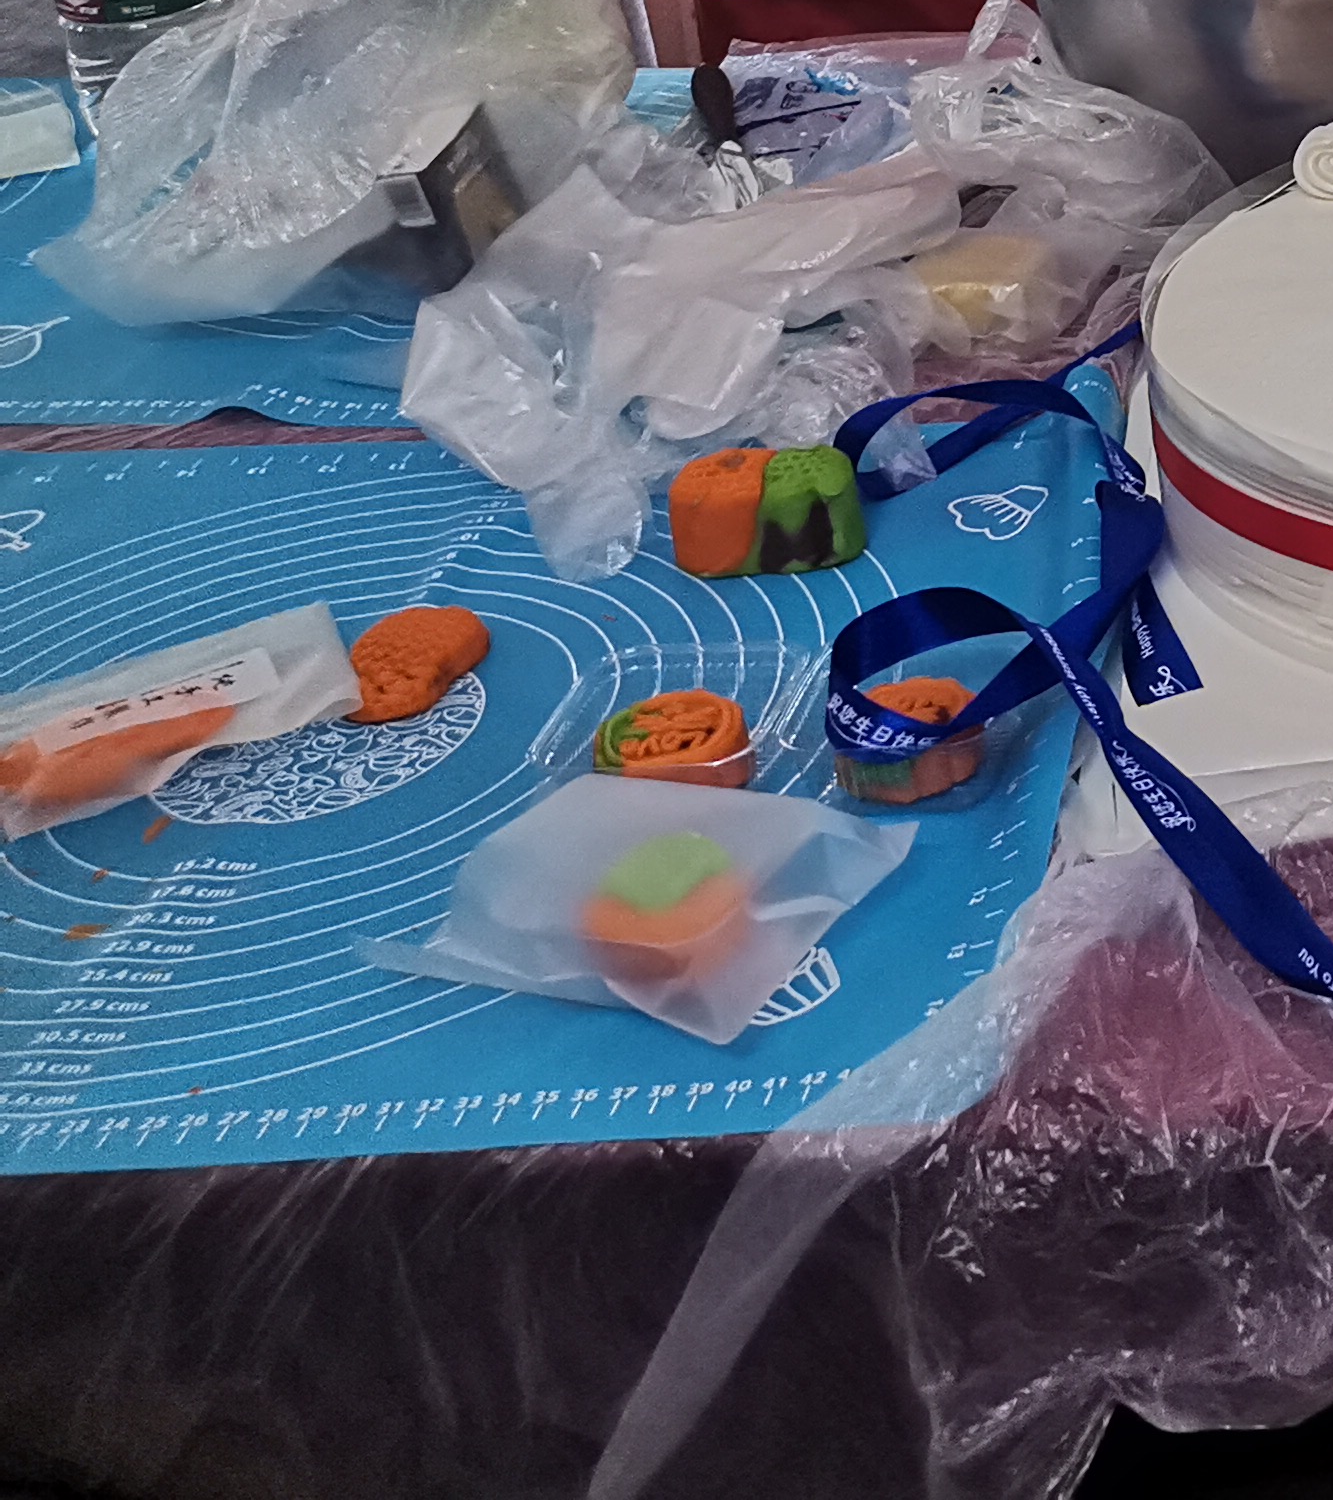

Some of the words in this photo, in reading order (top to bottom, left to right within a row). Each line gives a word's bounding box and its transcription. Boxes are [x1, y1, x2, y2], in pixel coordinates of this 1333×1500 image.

[215, 858, 258, 872] cms
[195, 886, 238, 898] cms
[173, 914, 218, 926] cms
[152, 942, 196, 954] cms
[1296, 946, 1322, 980] You
[129, 970, 175, 983] cms
[106, 1002, 152, 1013] cms
[82, 1032, 127, 1043] cms
[48, 1062, 93, 1074] cms
[33, 1093, 79, 1105] cms
